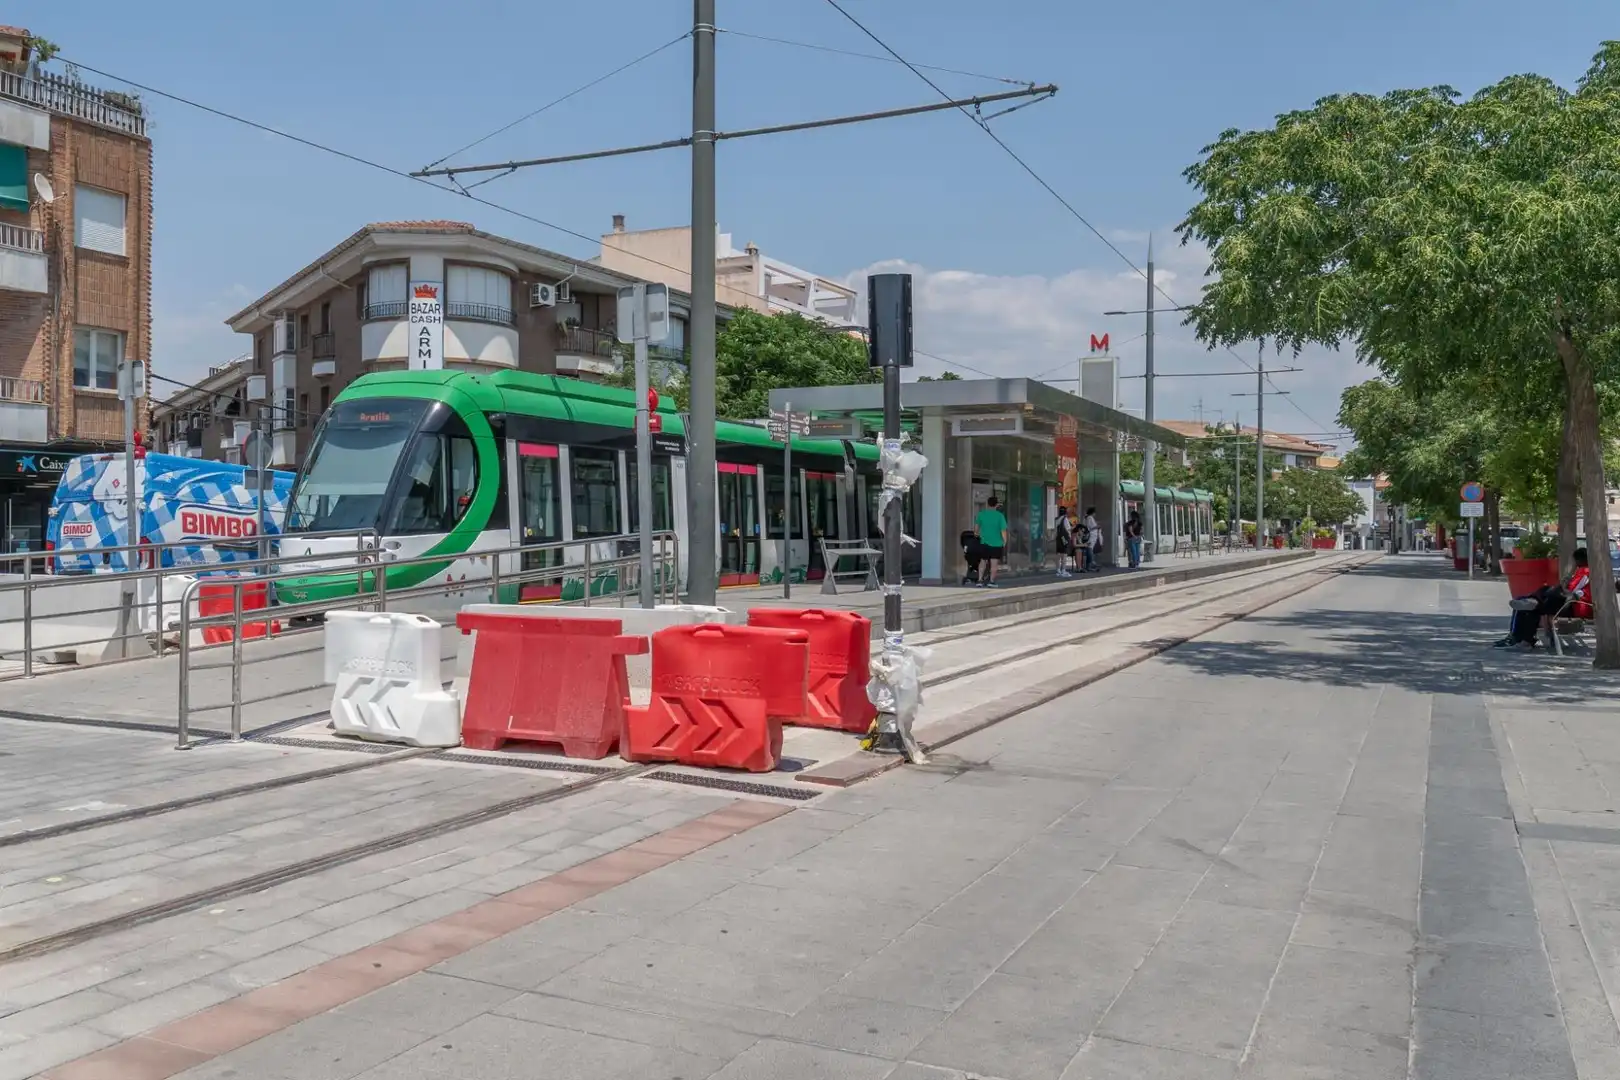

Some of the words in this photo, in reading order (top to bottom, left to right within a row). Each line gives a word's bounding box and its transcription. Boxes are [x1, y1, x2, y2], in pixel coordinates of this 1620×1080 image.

[411, 303, 441, 314] BAZAR
[411, 315, 441, 324] CASH
[418, 326, 431, 369] ARMI
[1090, 333, 1109, 352] M
[63, 524, 93, 535] BIMBO
[182, 512, 257, 537] BIMBO
